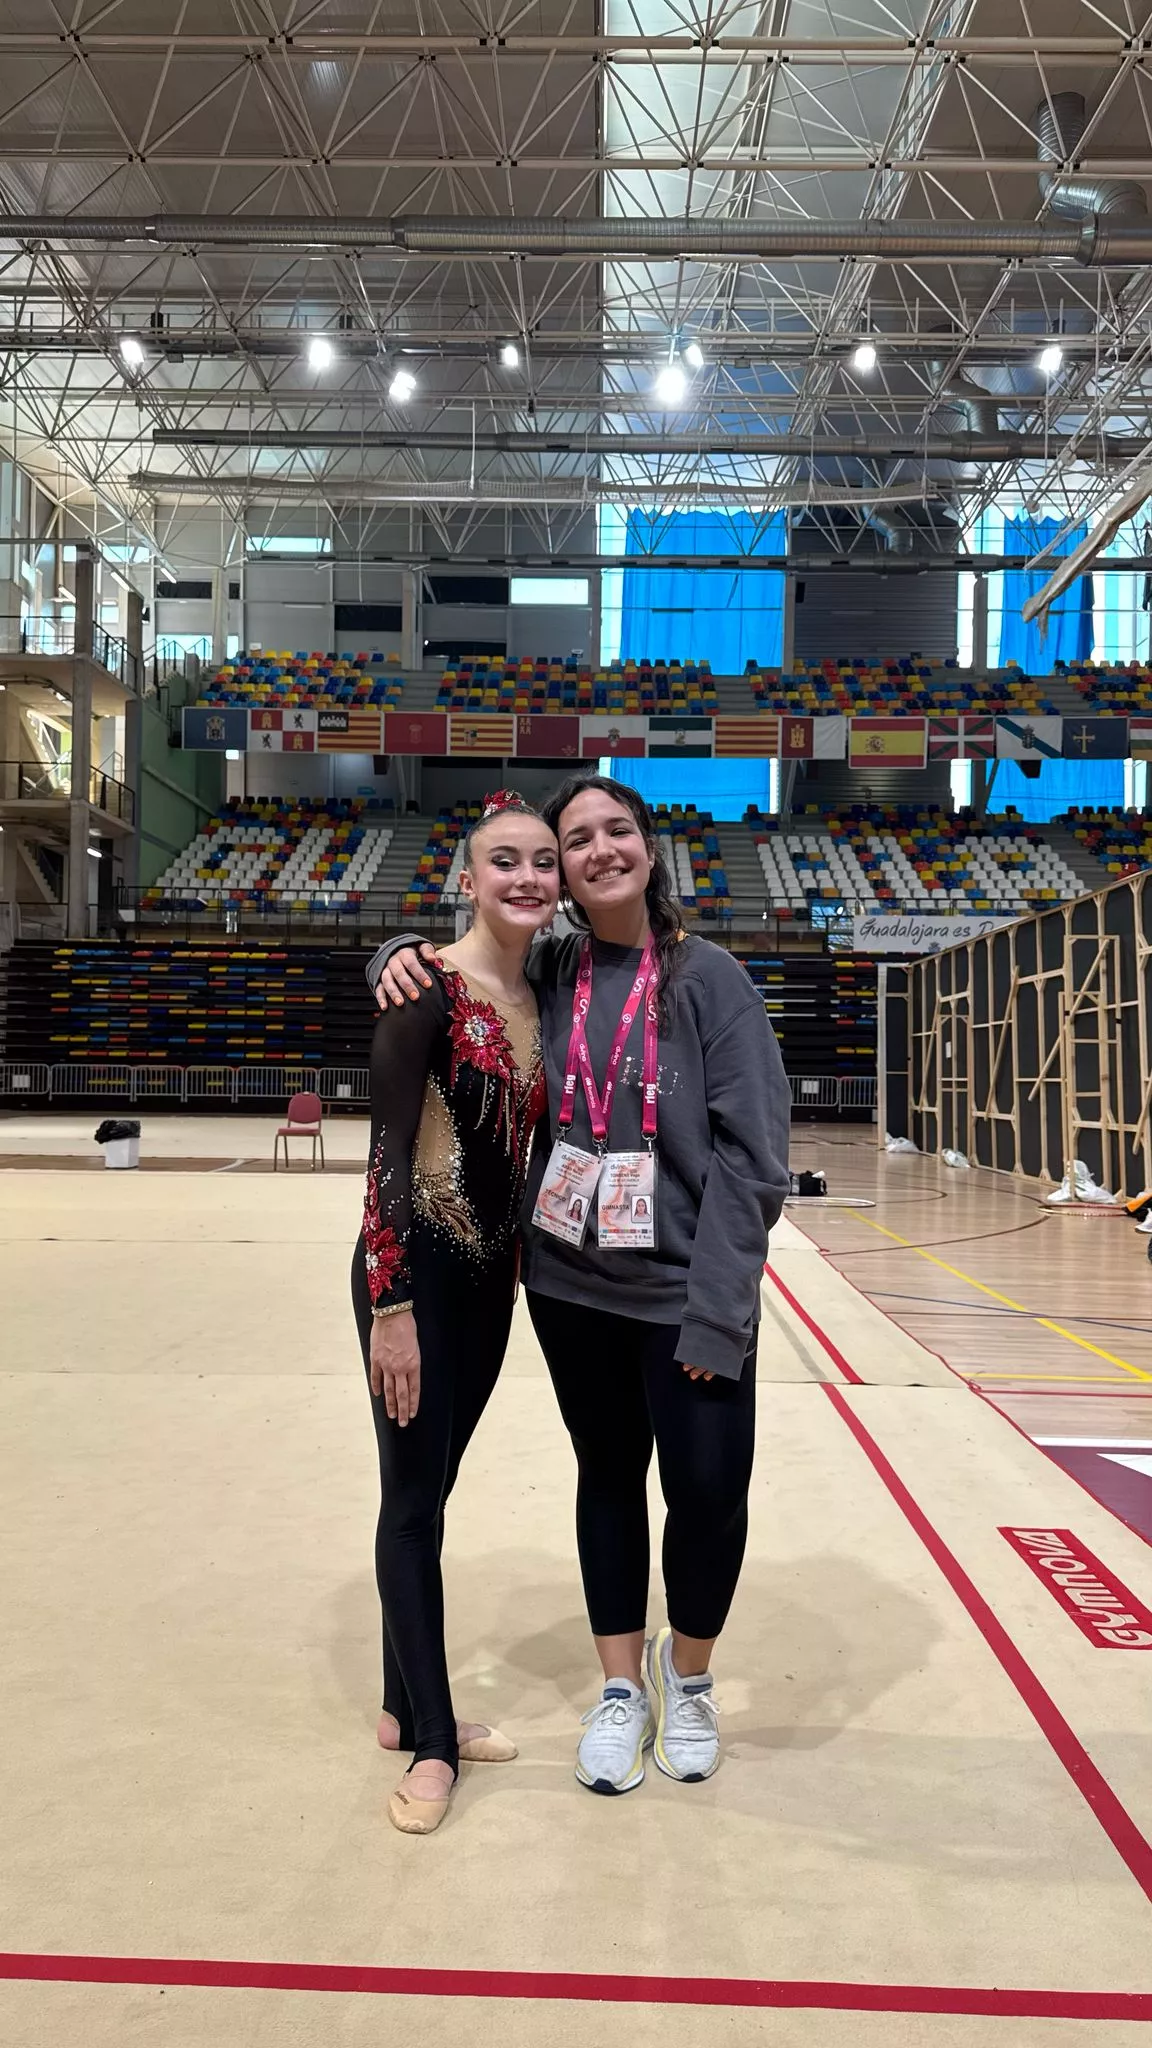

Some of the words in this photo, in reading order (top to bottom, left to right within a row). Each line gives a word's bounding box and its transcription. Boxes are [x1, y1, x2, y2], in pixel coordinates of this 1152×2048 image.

[859, 917, 949, 945] Guadalajara
[952, 925, 971, 938] es
[564, 1074, 576, 1095] rfeg
[645, 1084, 657, 1104] rfeg
